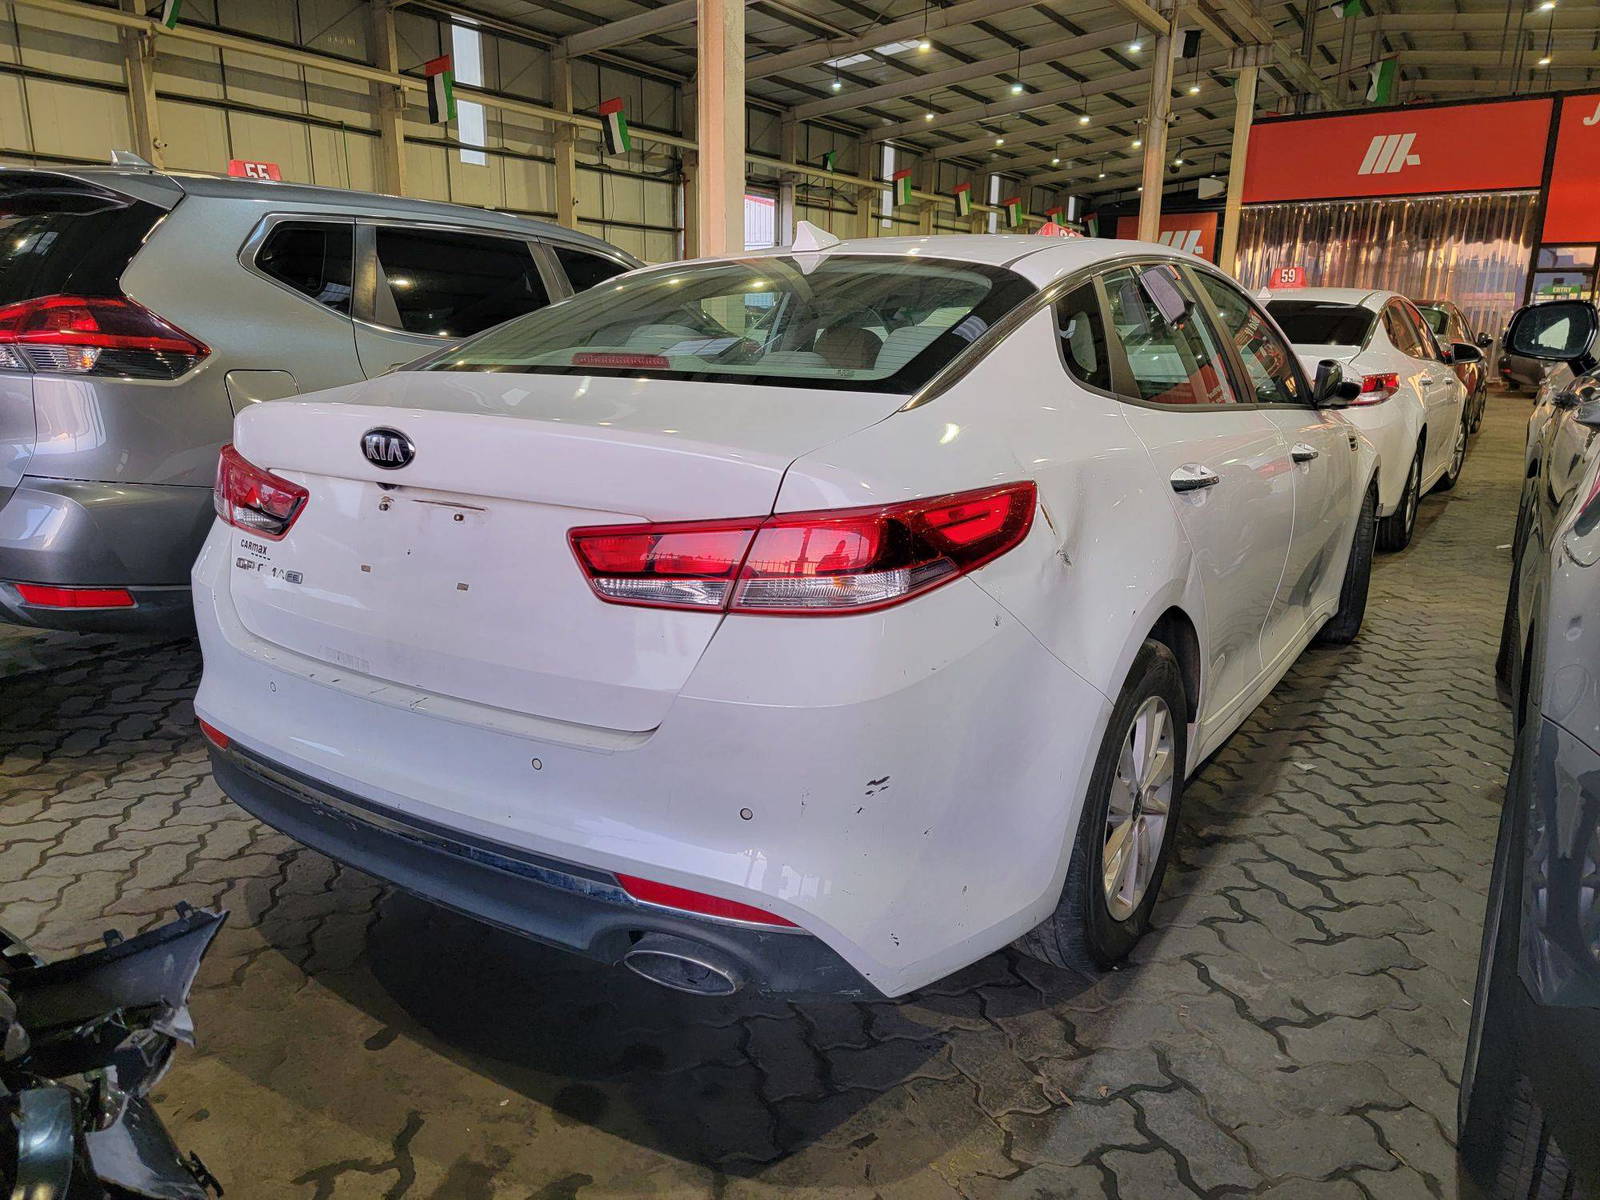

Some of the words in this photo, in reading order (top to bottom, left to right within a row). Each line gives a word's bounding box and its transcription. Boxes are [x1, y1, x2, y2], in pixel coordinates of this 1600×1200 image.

[245, 163, 270, 179] 55
[1281, 268, 1296, 283] 59
[365, 434, 404, 462] KIA
